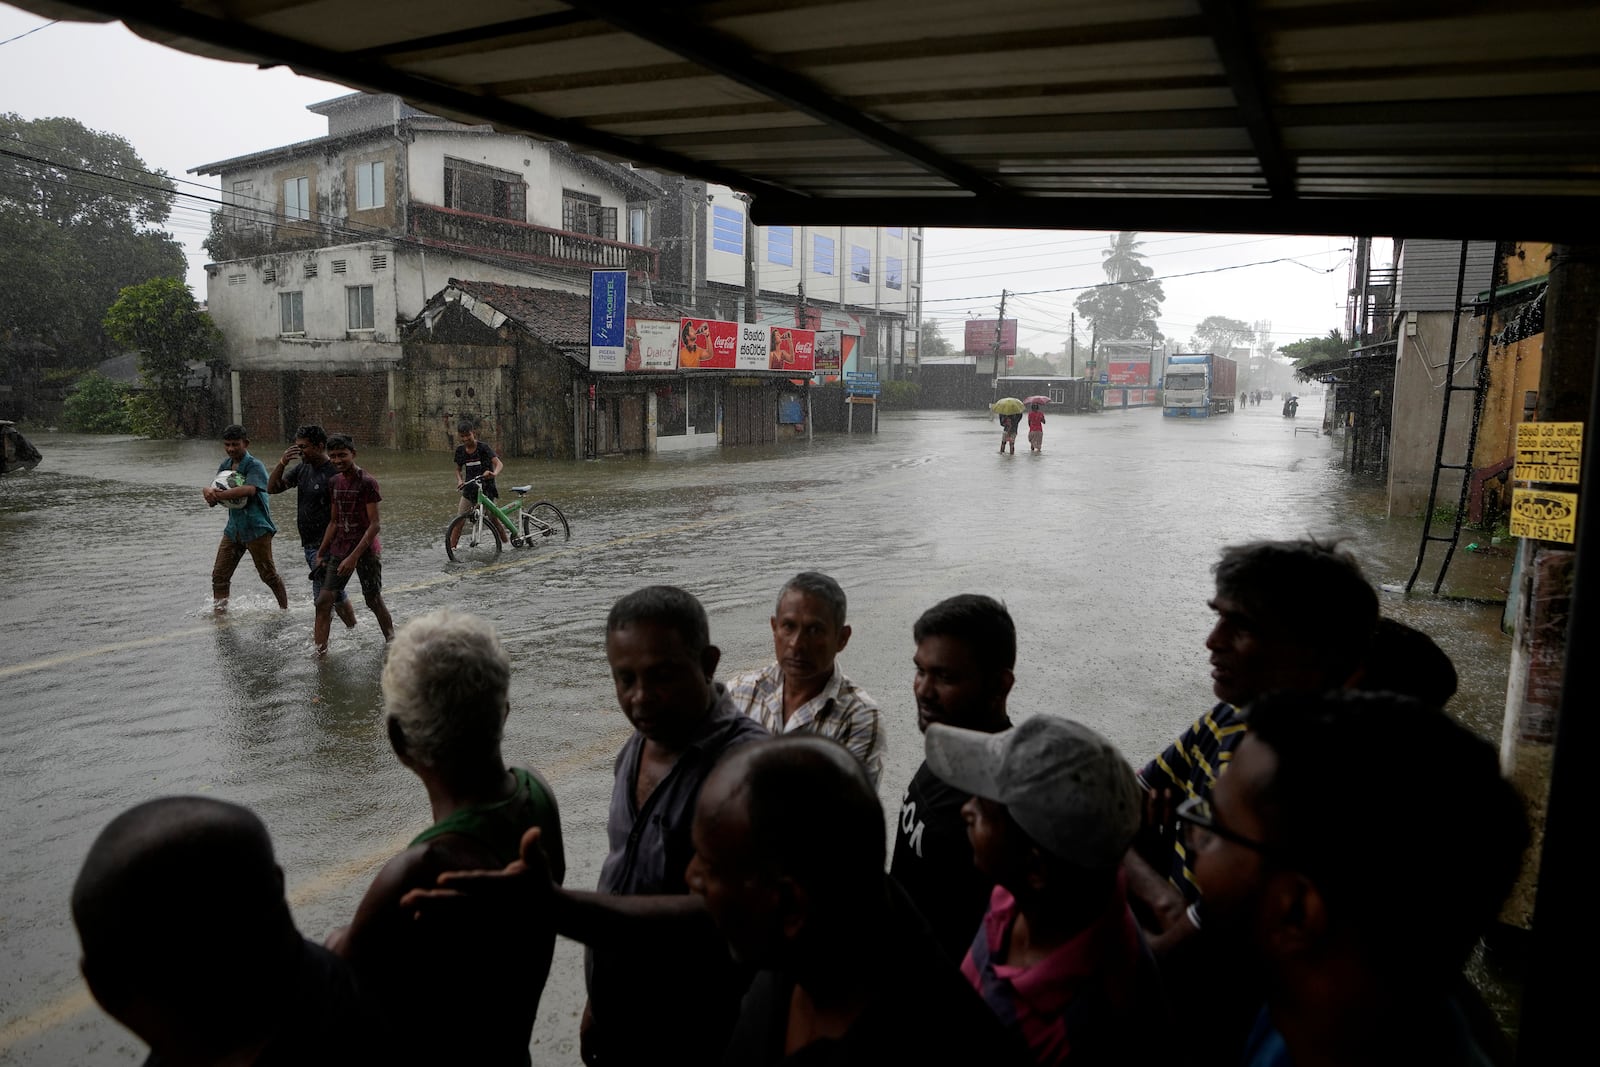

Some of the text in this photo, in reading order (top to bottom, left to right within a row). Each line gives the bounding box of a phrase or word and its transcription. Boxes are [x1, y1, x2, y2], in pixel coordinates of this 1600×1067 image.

[646, 346, 672, 360] Dialog
[1533, 525, 1549, 538] 154
[1552, 527, 1571, 542] 347
